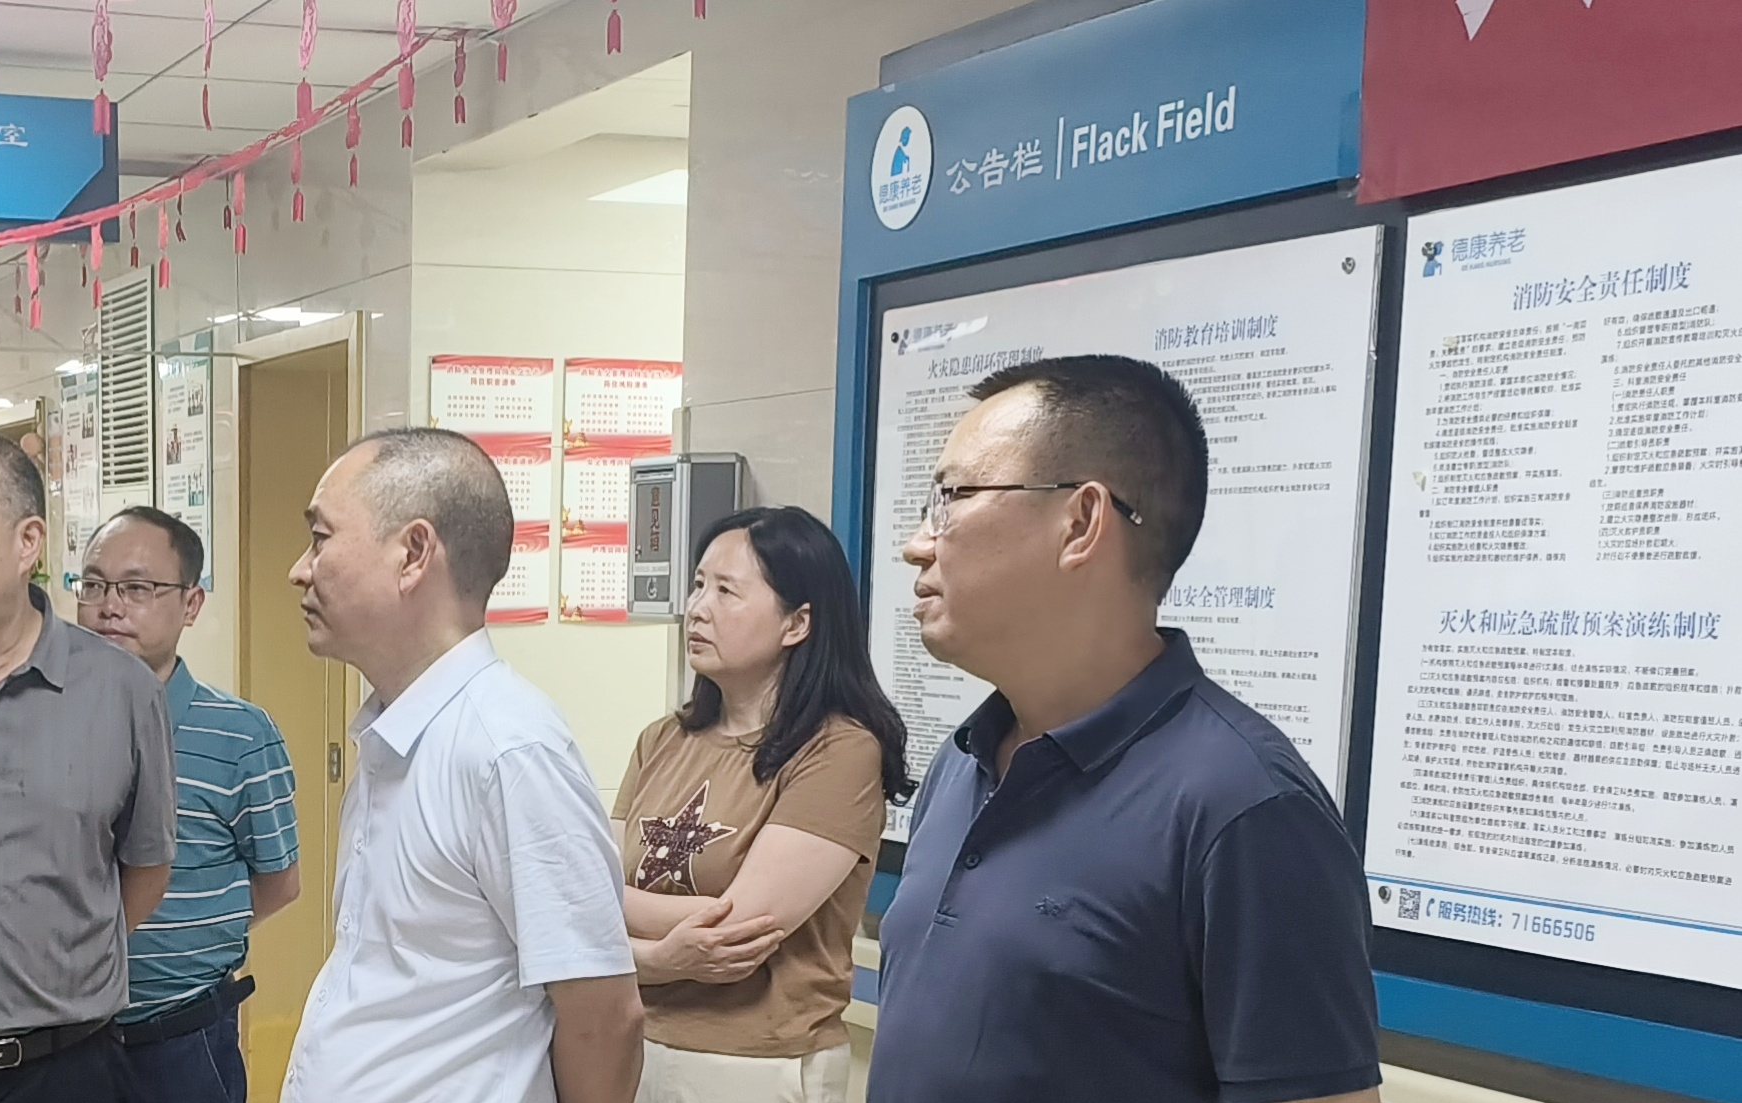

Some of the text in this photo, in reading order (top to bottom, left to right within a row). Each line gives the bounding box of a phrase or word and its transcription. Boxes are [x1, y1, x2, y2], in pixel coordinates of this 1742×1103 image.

[1071, 86, 1236, 169] Flack Field
[945, 138, 1044, 195] 公告栏
[1451, 227, 1527, 263] 德康养老
[1512, 261, 1692, 311] 消防安全责任制度
[1154, 313, 1278, 351] 消防教育培训制度
[1438, 608, 1722, 640] 灭火和应急疏散预案演练制度
[1437, 899, 1596, 943] 服务热线： 71666506
